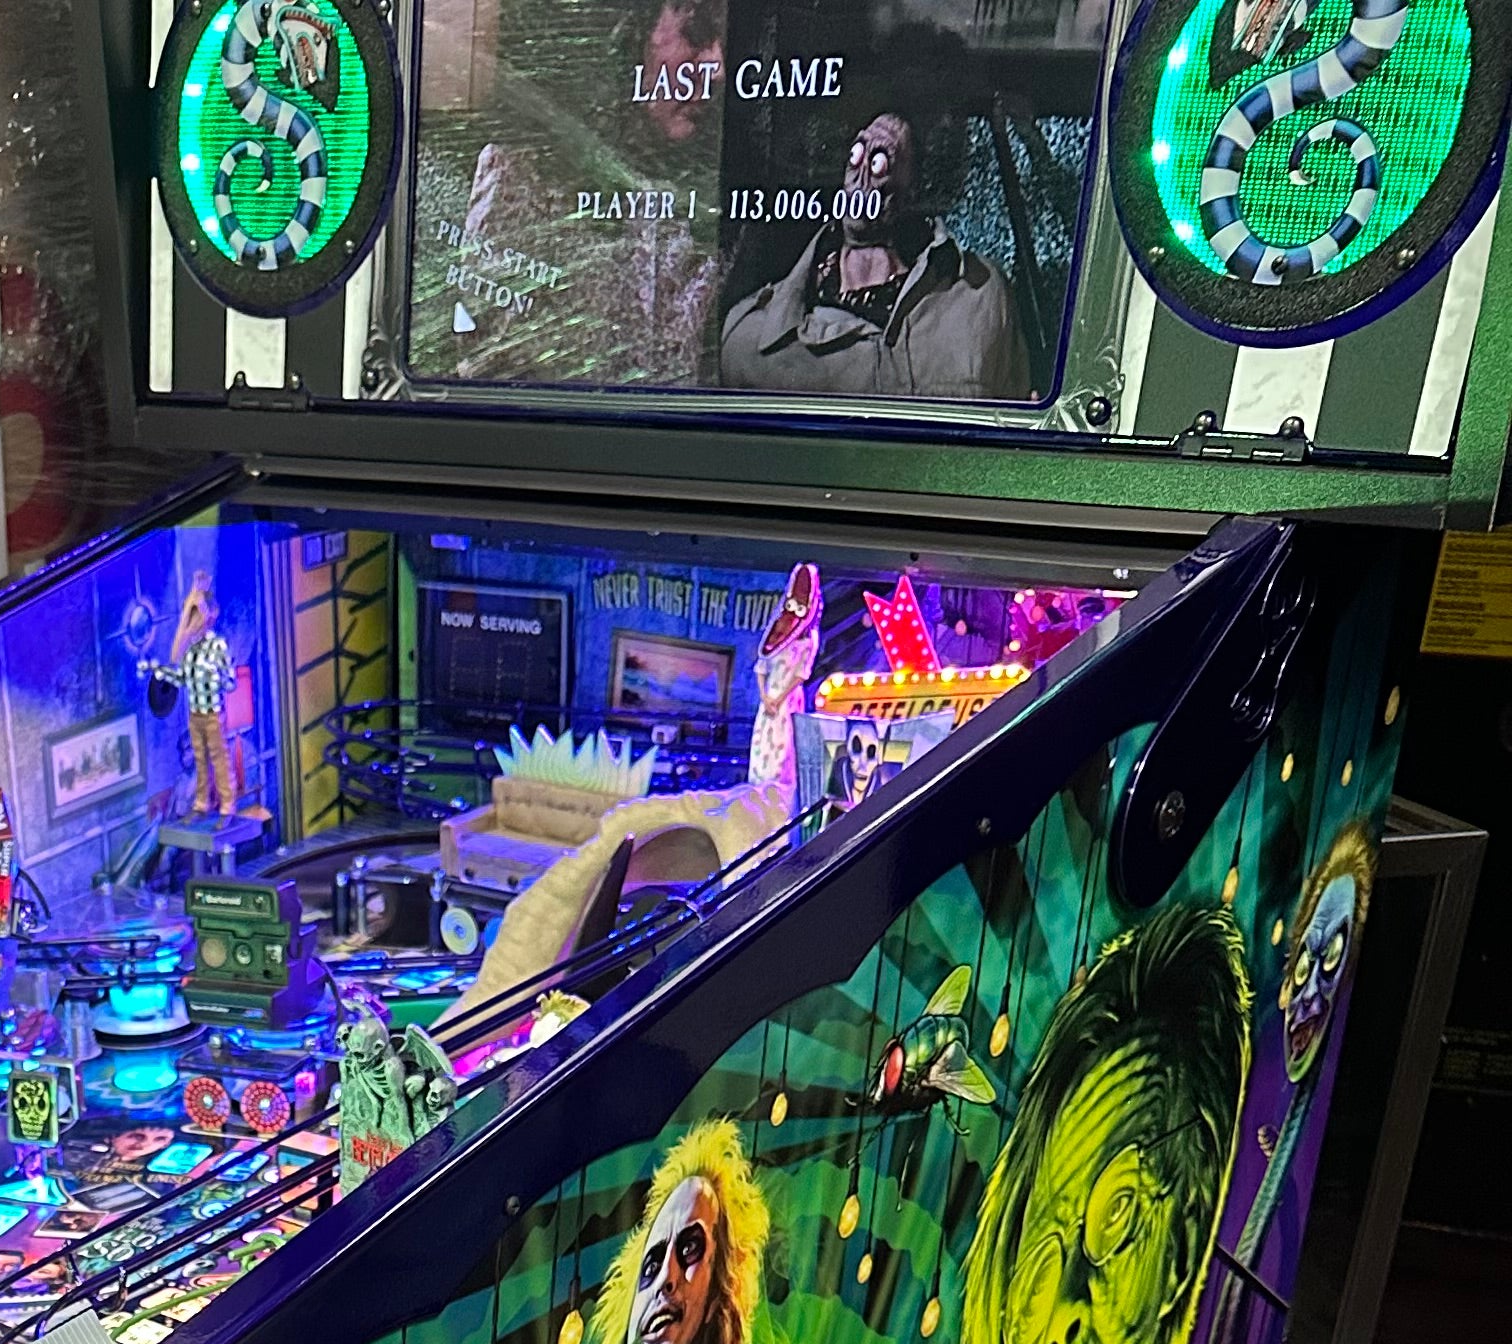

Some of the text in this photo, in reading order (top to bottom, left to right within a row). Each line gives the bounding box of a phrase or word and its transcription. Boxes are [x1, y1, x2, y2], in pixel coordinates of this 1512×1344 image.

[632, 57, 845, 102] LAST GAME
[577, 190, 678, 221] PLAYER
[687, 191, 697, 219] 1
[729, 189, 882, 223] 113,006,000
[436, 218, 565, 289] PRESS START
[445, 262, 536, 317] BUTTON!
[441, 611, 543, 637] NOW SERVING
[592, 573, 640, 612] NEVER
[647, 576, 694, 619] TRUST
[700, 586, 728, 627] THE
